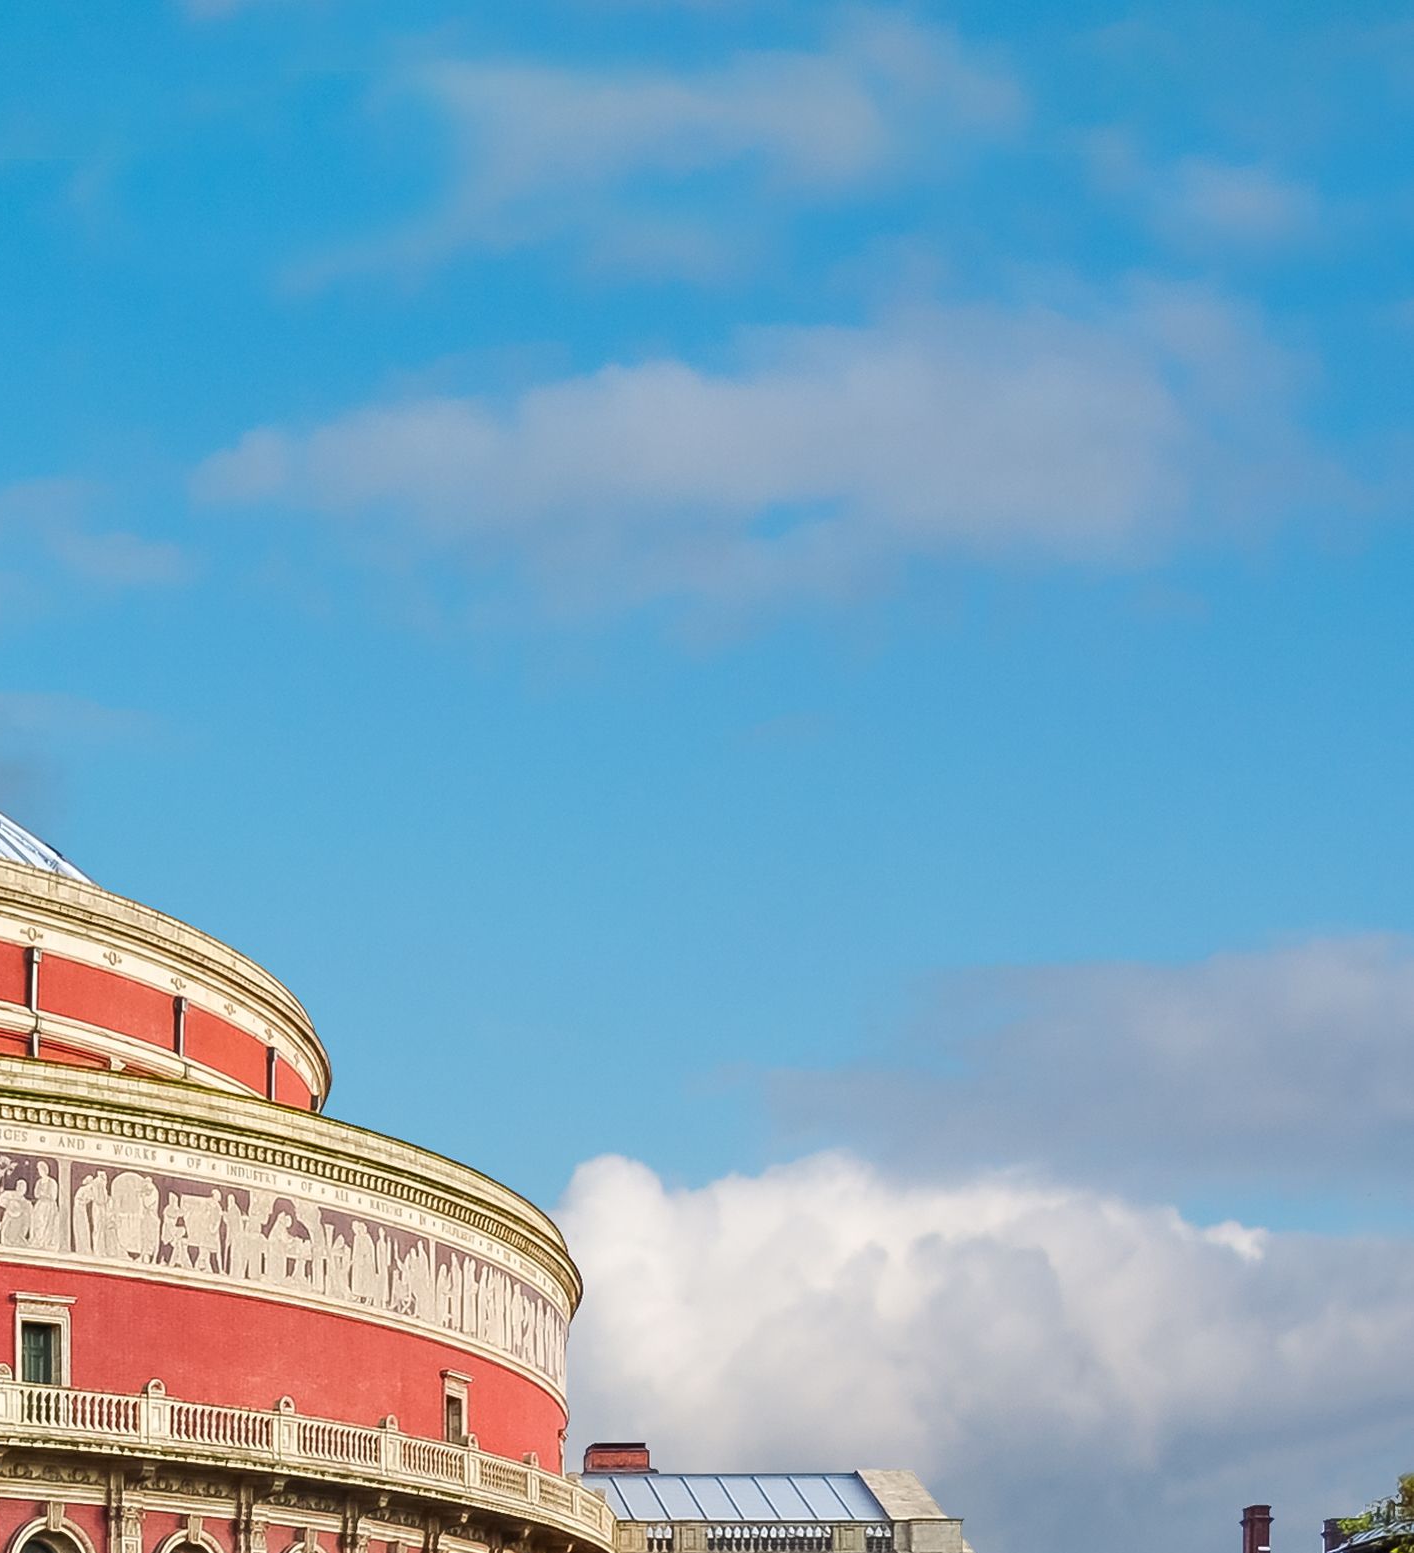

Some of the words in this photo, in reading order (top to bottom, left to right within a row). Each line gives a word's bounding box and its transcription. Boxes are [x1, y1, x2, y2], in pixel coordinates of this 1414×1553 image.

[58, 1136, 86, 1151] AND
[112, 1143, 157, 1162] WORKS
[186, 1156, 202, 1170] OF
[226, 1163, 279, 1186] INDUSTRY
